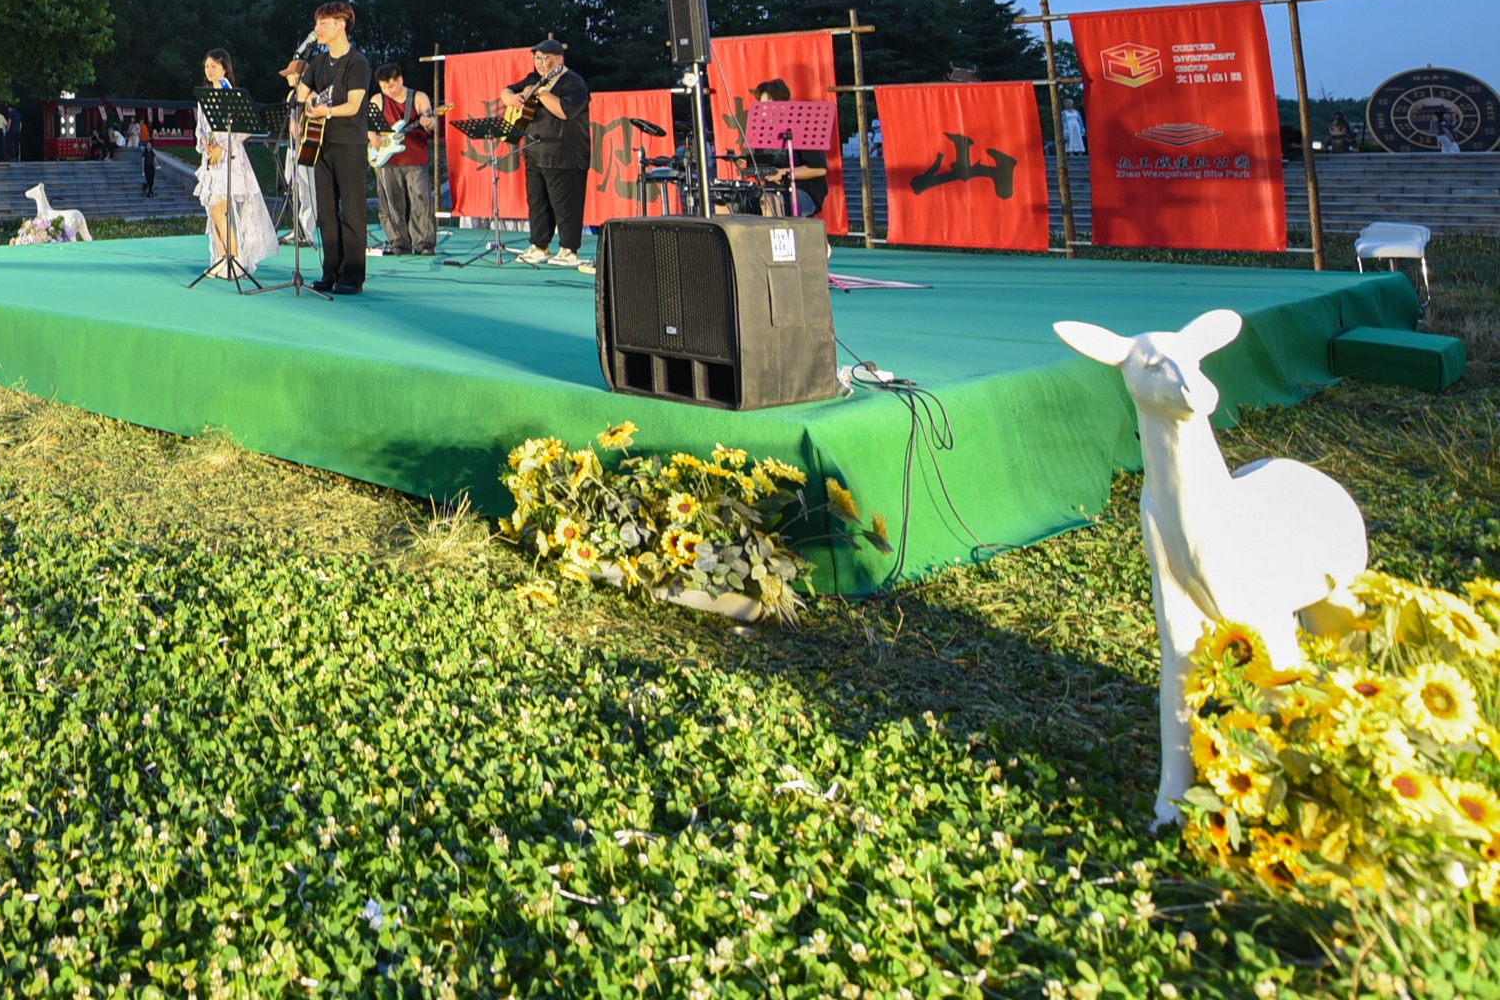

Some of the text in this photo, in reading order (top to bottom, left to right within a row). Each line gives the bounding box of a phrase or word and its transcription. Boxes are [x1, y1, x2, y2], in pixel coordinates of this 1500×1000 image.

[910, 132, 1018, 200] 山
[1115, 169, 1251, 179] Zhao Wangcheng Site Park
